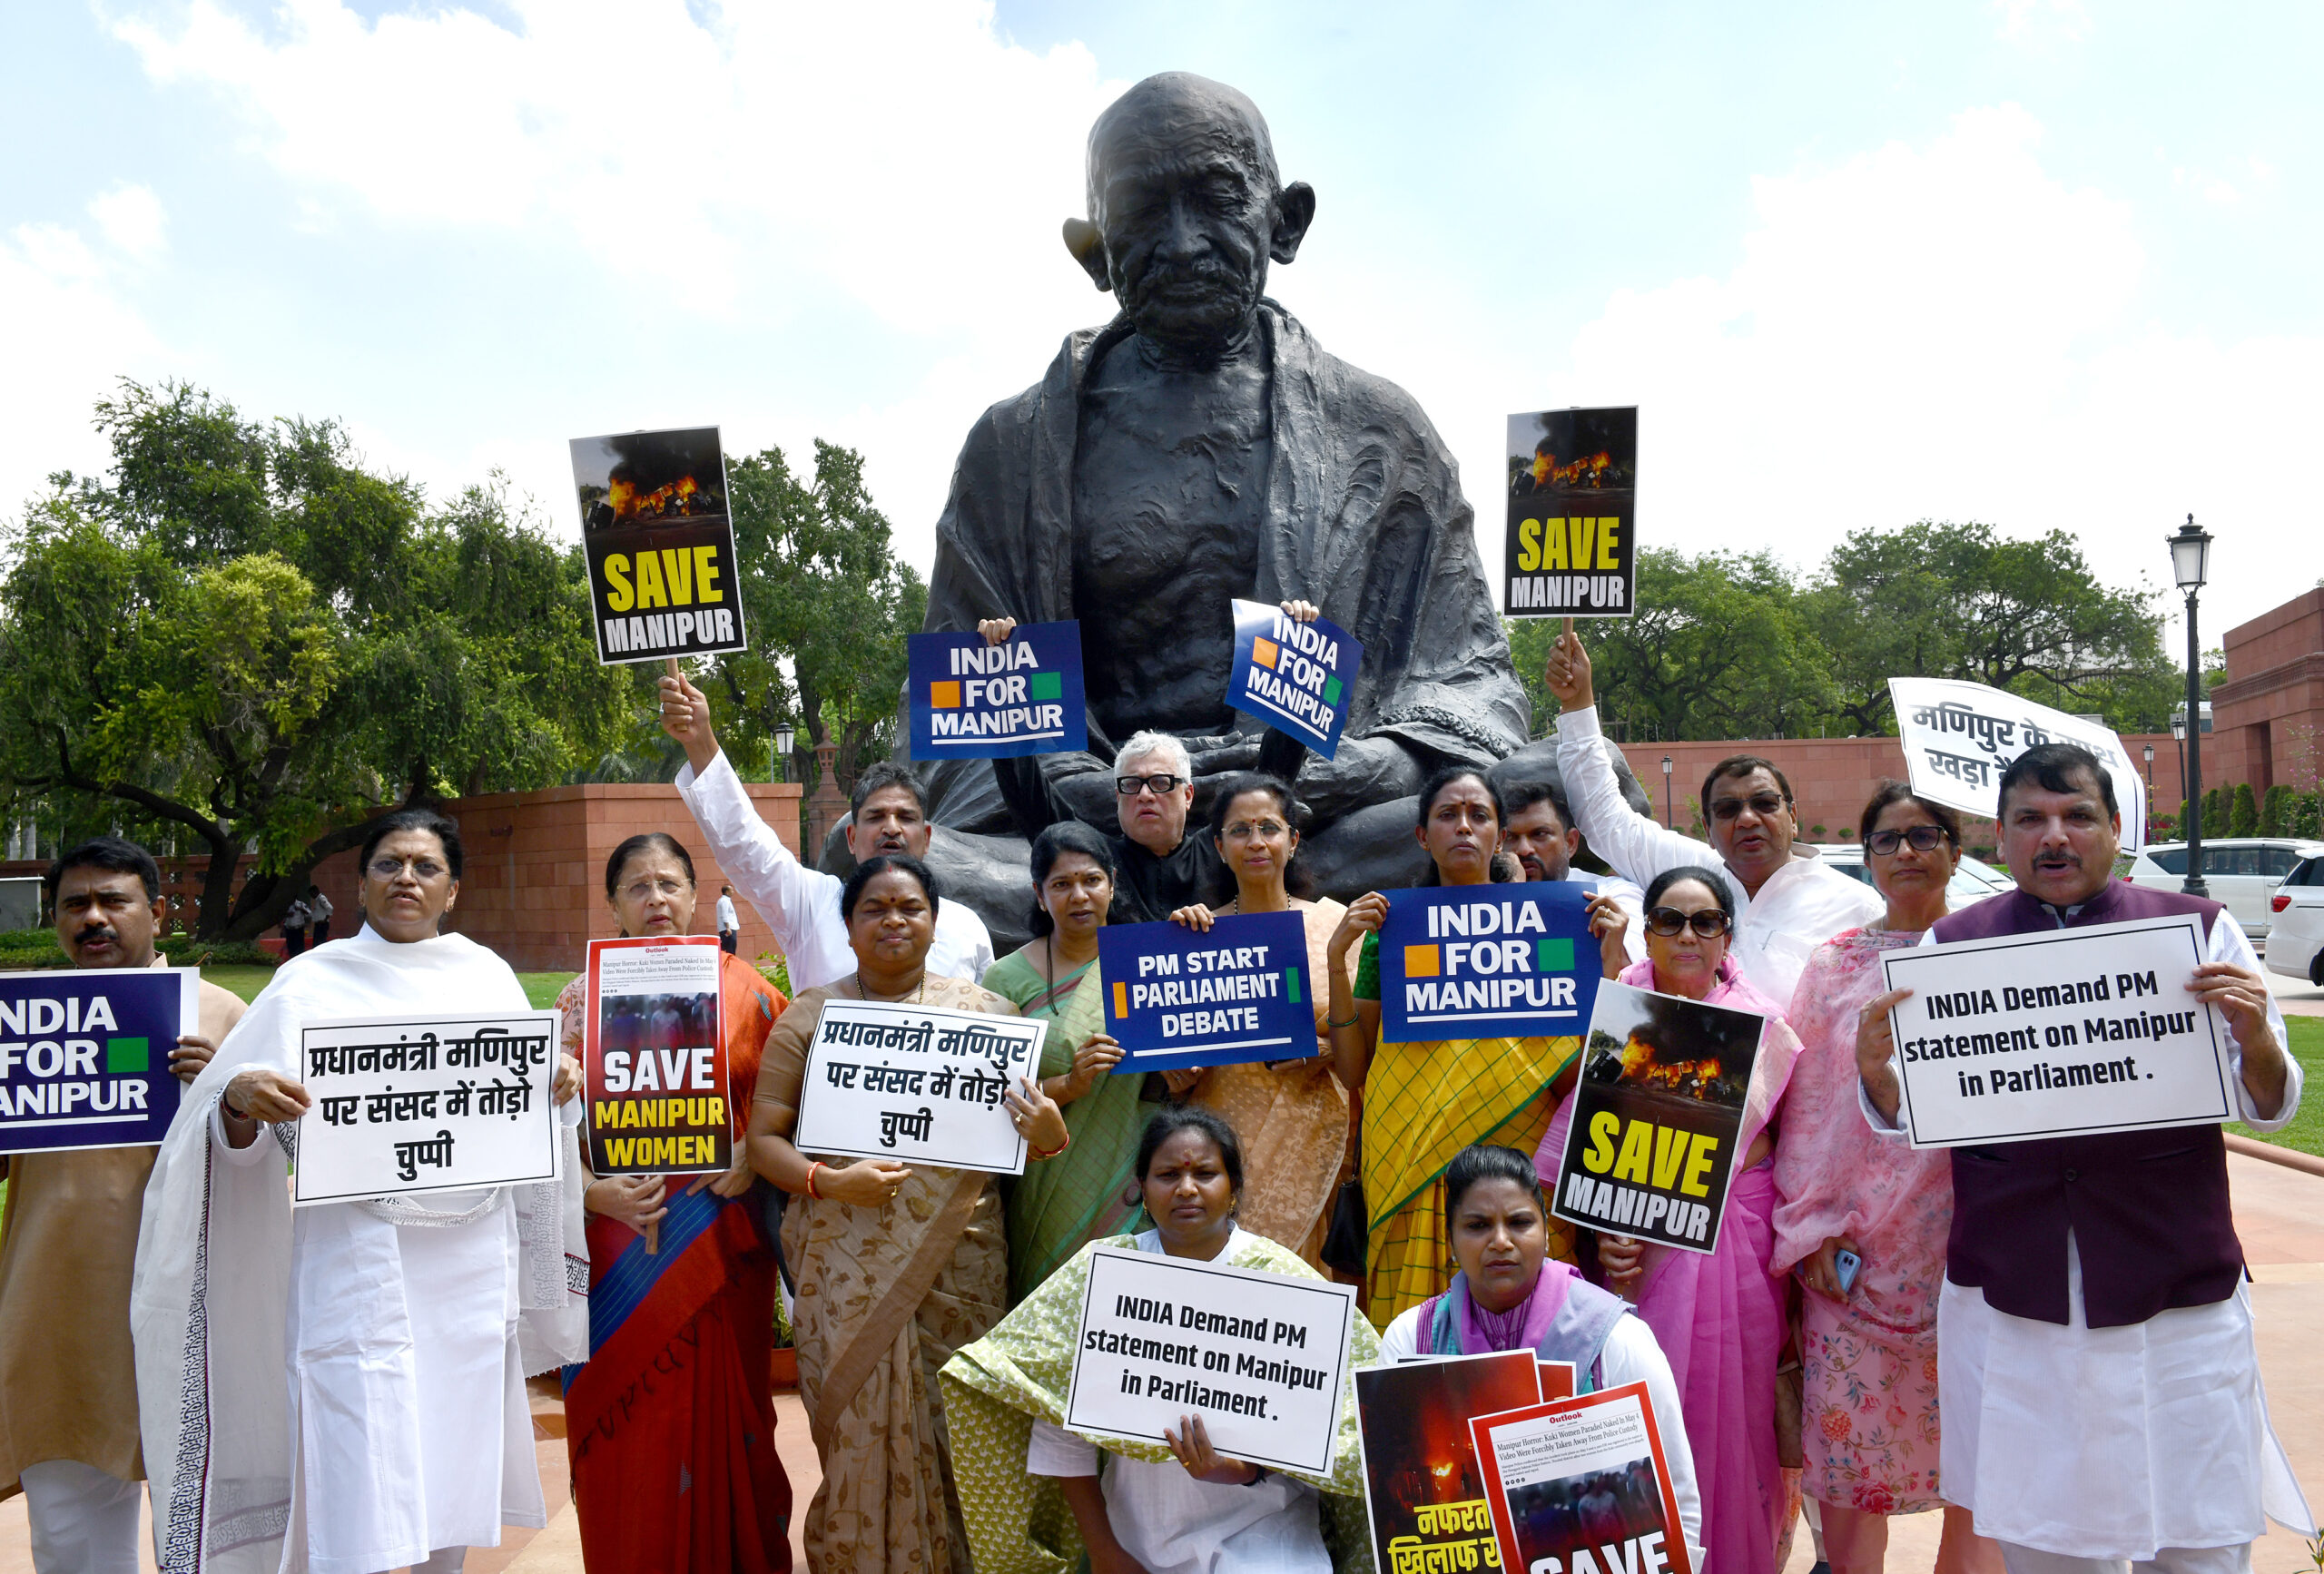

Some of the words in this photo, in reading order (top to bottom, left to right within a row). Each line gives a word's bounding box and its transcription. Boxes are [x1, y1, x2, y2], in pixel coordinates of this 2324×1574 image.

[1517, 516, 1620, 572] SAVE
[604, 546, 724, 613] SAVE
[1511, 575, 1625, 608] MANIPUR
[604, 608, 734, 653] MANIPUR
[1273, 615, 1338, 671] INDIA
[950, 641, 1039, 675] INDIA
[1277, 647, 1325, 696] FOR
[965, 675, 1028, 707] FOR
[1247, 665, 1334, 733] MANIPUR
[931, 703, 1063, 736] MANIPUR
[1908, 701, 2015, 753] मणिपुर
[1428, 900, 1547, 938] INDIA
[1138, 954, 1179, 978] PM
[1187, 946, 1269, 974] START
[1445, 939, 1531, 976] FOR
[1132, 972, 1280, 1009] PARLIAMENT
[1405, 977, 1577, 1012] MANIPUR
[1925, 989, 1998, 1020] INDIA
[2003, 975, 2111, 1012] Demand
[2116, 970, 2159, 999] PM
[0, 996, 118, 1036] NDIA
[1161, 1007, 1260, 1038] DEBATE
[1905, 1024, 2040, 1063] statement
[2044, 1022, 2078, 1048] on
[2083, 1010, 2197, 1044] Manipur
[0, 1039, 99, 1078] FOR
[309, 1032, 439, 1077] प्रधानमंत्री
[444, 1028, 549, 1076] मणिपुर
[822, 1019, 934, 1053] प्रधानमंत्री
[938, 1024, 1031, 1070] मणिपुर
[604, 1048, 714, 1092] SAVE
[826, 1061, 861, 1089] पर
[863, 1060, 927, 1096] संसद
[930, 1065, 960, 1098] में
[959, 1067, 1010, 1111] तोड़ो
[1958, 1070, 1984, 1097] in
[1990, 1055, 2138, 1096] Parliament
[0, 1079, 149, 1116] ANIPUR
[320, 1095, 360, 1126] पर
[365, 1085, 439, 1124] संसद
[444, 1080, 476, 1117] में
[477, 1077, 533, 1121] तोड़ो
[595, 1097, 725, 1129] MANIPUR
[879, 1107, 934, 1148] चुप्पी
[394, 1129, 455, 1181] चुप्पी
[604, 1135, 715, 1166] WOMEN
[1582, 1110, 1719, 1198] SAVE
[1563, 1172, 1711, 1242] MANIPUR
[1115, 1294, 1174, 1325] INDIA
[1179, 1305, 1268, 1342] Demand
[1273, 1322, 1307, 1349] PM
[1085, 1329, 1198, 1367] statement
[1203, 1350, 1230, 1373] on
[1236, 1353, 1328, 1391] Manipur
[1120, 1369, 1142, 1396] in
[1147, 1374, 1267, 1419] Parliament
[1497, 1440, 1522, 1451] Manipur
[1522, 1436, 1544, 1448] Horror:
[1543, 1431, 1558, 1442] Kuki
[1559, 1428, 1581, 1441] Women
[1581, 1422, 1603, 1436] Paraded
[1603, 1419, 1620, 1431] Naked
[1625, 1414, 1636, 1425] May
[1549, 1412, 1582, 1424] Outlook
[1499, 1451, 1516, 1461] Video
[1516, 1447, 1531, 1458] Were
[1531, 1441, 1555, 1456] Forcibly
[1555, 1439, 1572, 1451] Taken
[1573, 1435, 1588, 1448] Away
[1588, 1431, 1603, 1443] From
[1603, 1427, 1619, 1439] Police
[1618, 1422, 1639, 1436] Custody
[1413, 1499, 1491, 1536] नफरत
